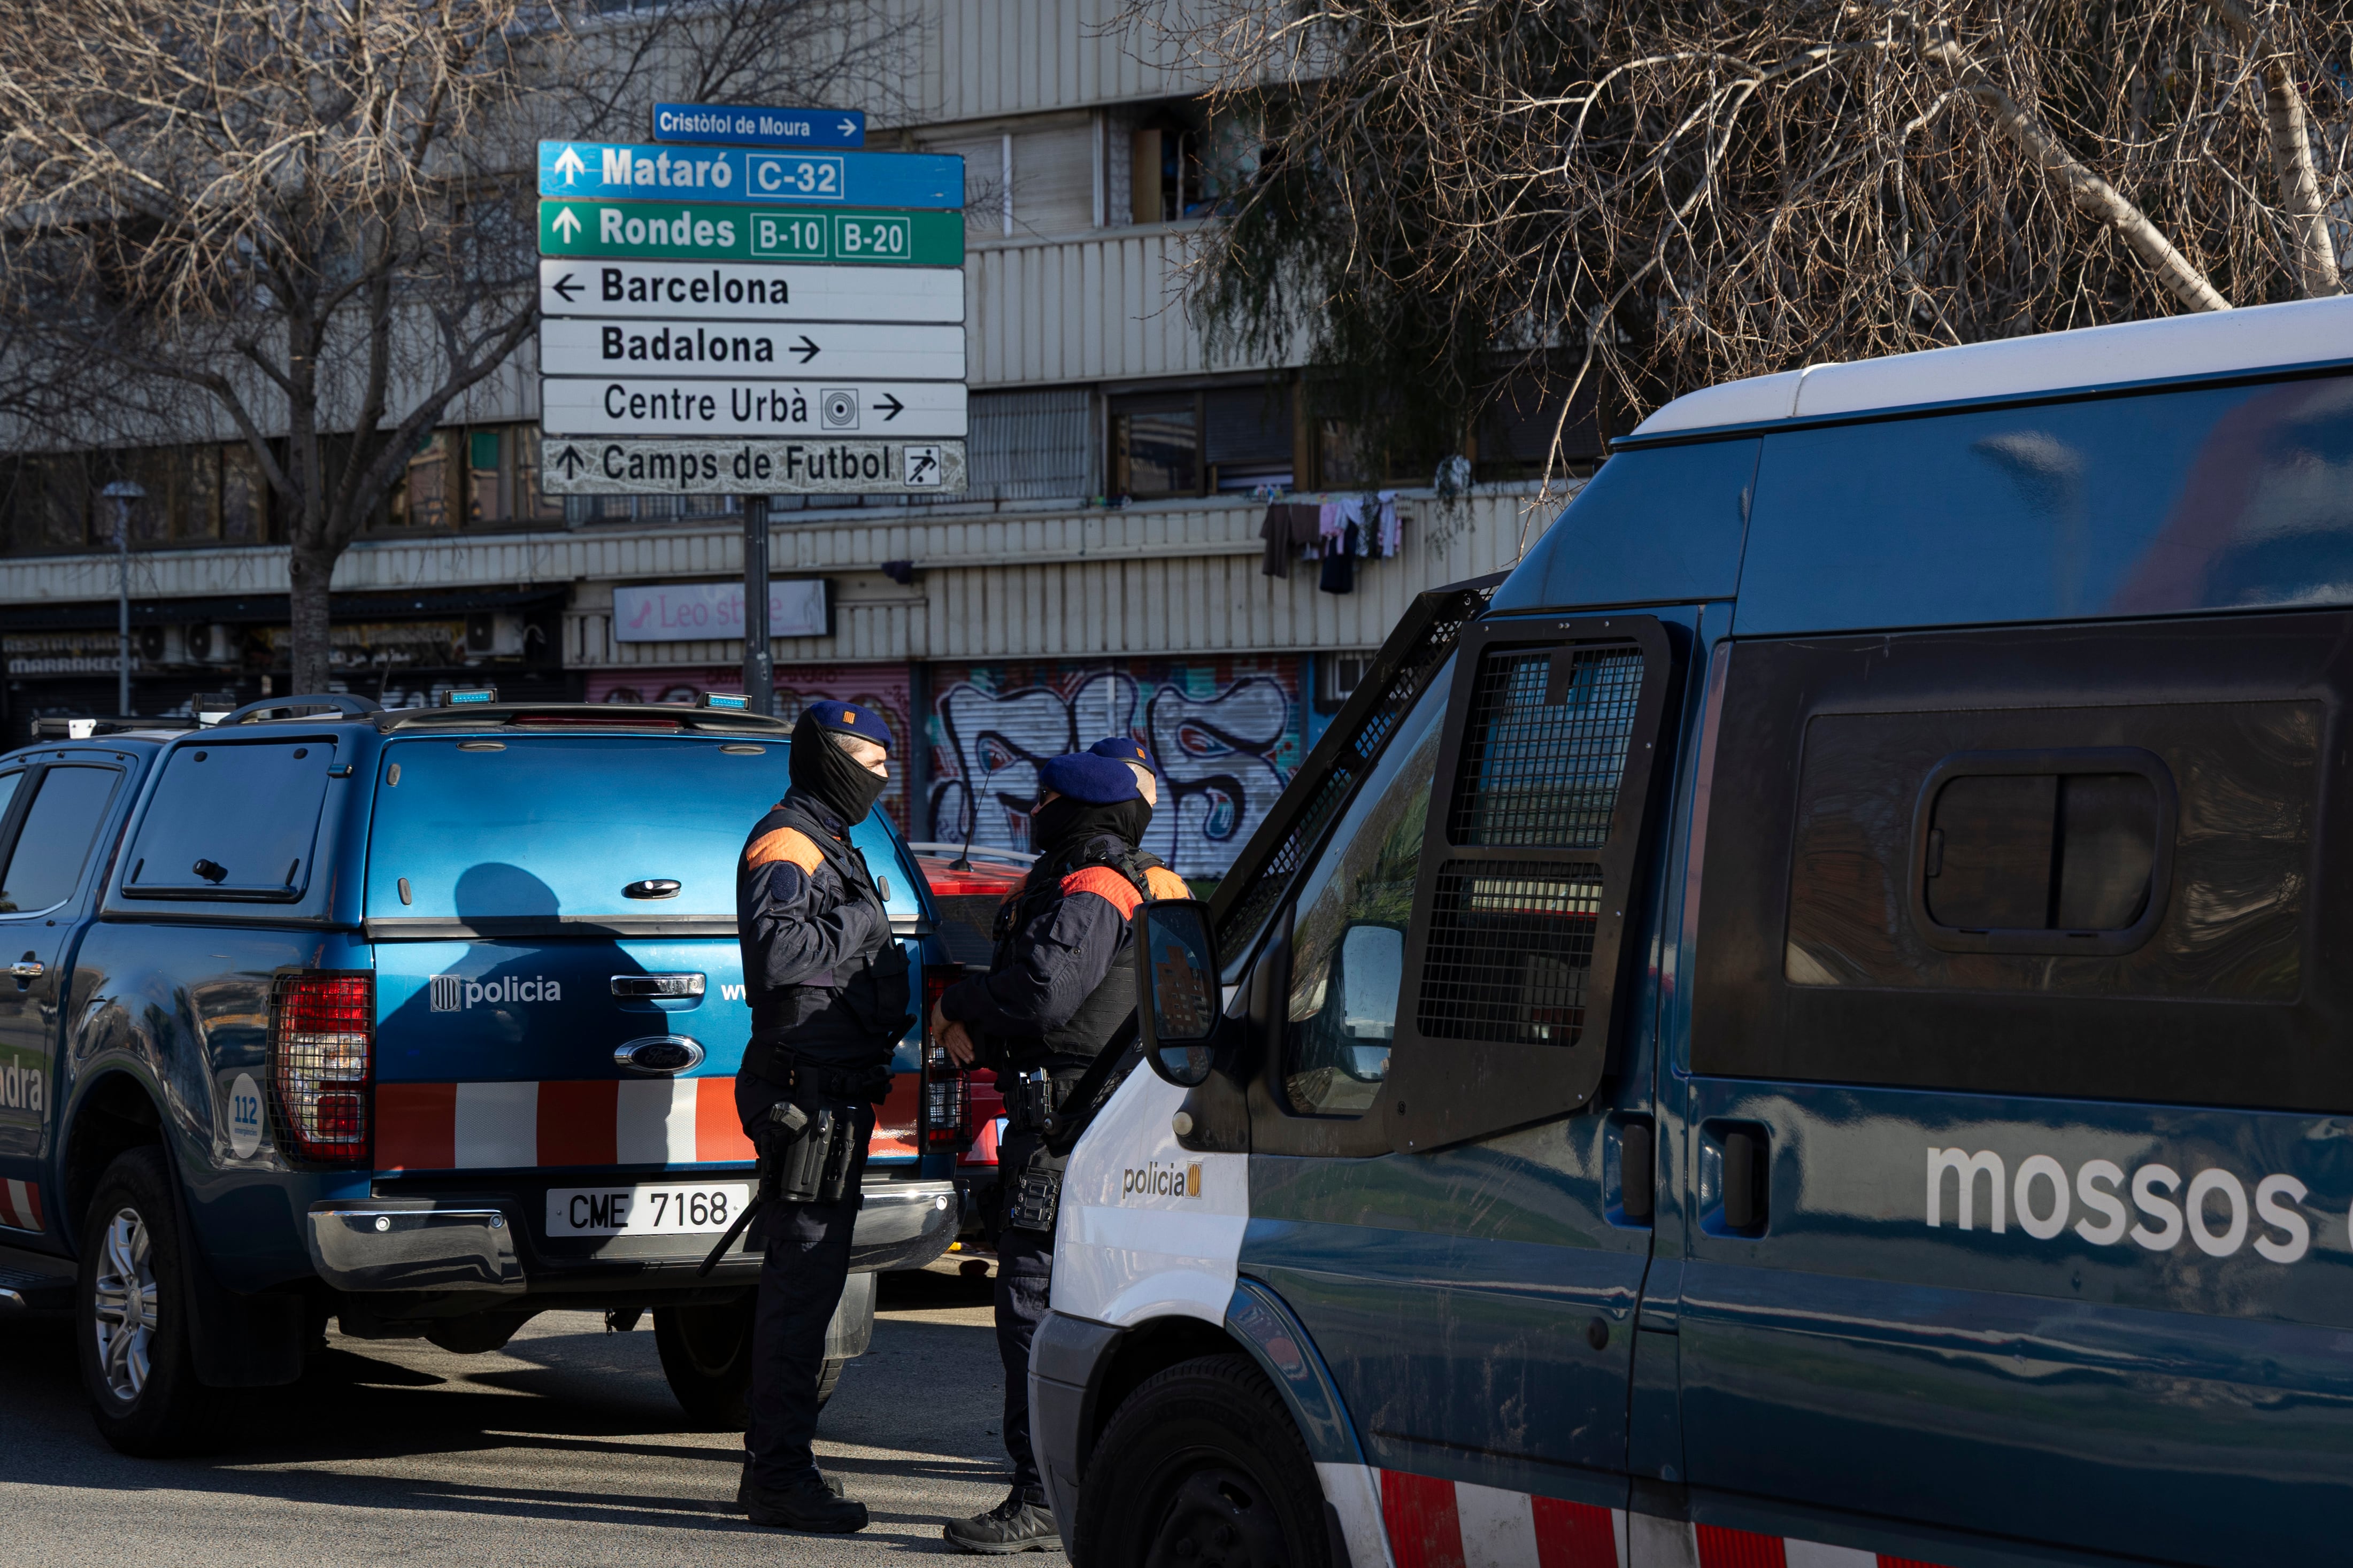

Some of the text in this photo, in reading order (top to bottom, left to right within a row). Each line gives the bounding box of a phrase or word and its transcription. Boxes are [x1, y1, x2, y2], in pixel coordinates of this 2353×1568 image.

[659, 111, 811, 137] Cristòfol de Moura
[601, 148, 837, 192] Mataró C-32
[600, 208, 903, 253] Rondes B-10 B-20
[602, 268, 789, 304] Barcelona
[602, 326, 774, 362] Badalona
[604, 384, 808, 423] Centre Urbà
[602, 445, 890, 488] Camps de Futbol
[658, 594, 708, 628] Leo
[465, 975, 562, 1008] policia
[234, 1095, 258, 1125] 112
[1122, 1161, 1185, 1199] policia
[569, 1192, 728, 1229] CME 7168
[1926, 1147, 2310, 1264] mossos
